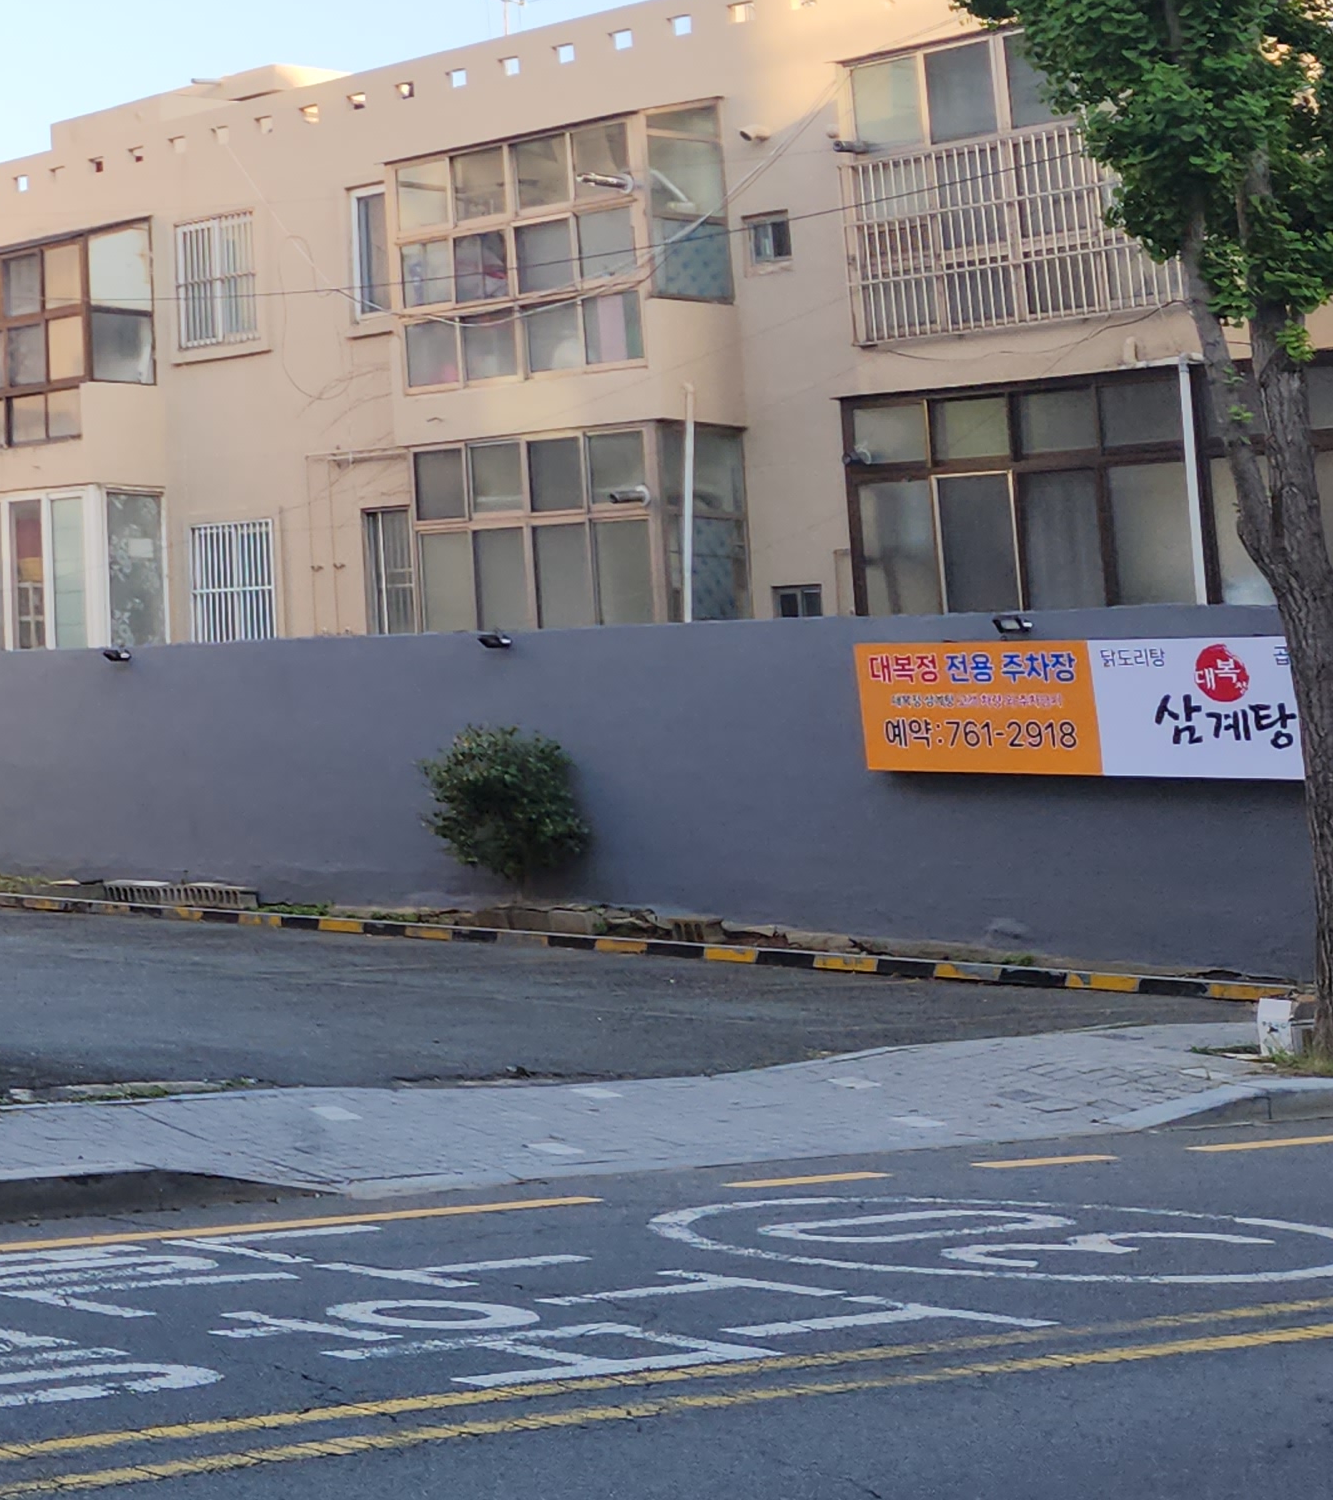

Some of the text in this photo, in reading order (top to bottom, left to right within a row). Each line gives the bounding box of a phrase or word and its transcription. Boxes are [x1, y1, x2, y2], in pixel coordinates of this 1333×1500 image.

[868, 652, 1076, 684] 대복정 전용 주차장
[1100, 648, 1165, 669] 닭도리탕
[1154, 693, 1298, 750] 삼계탕
